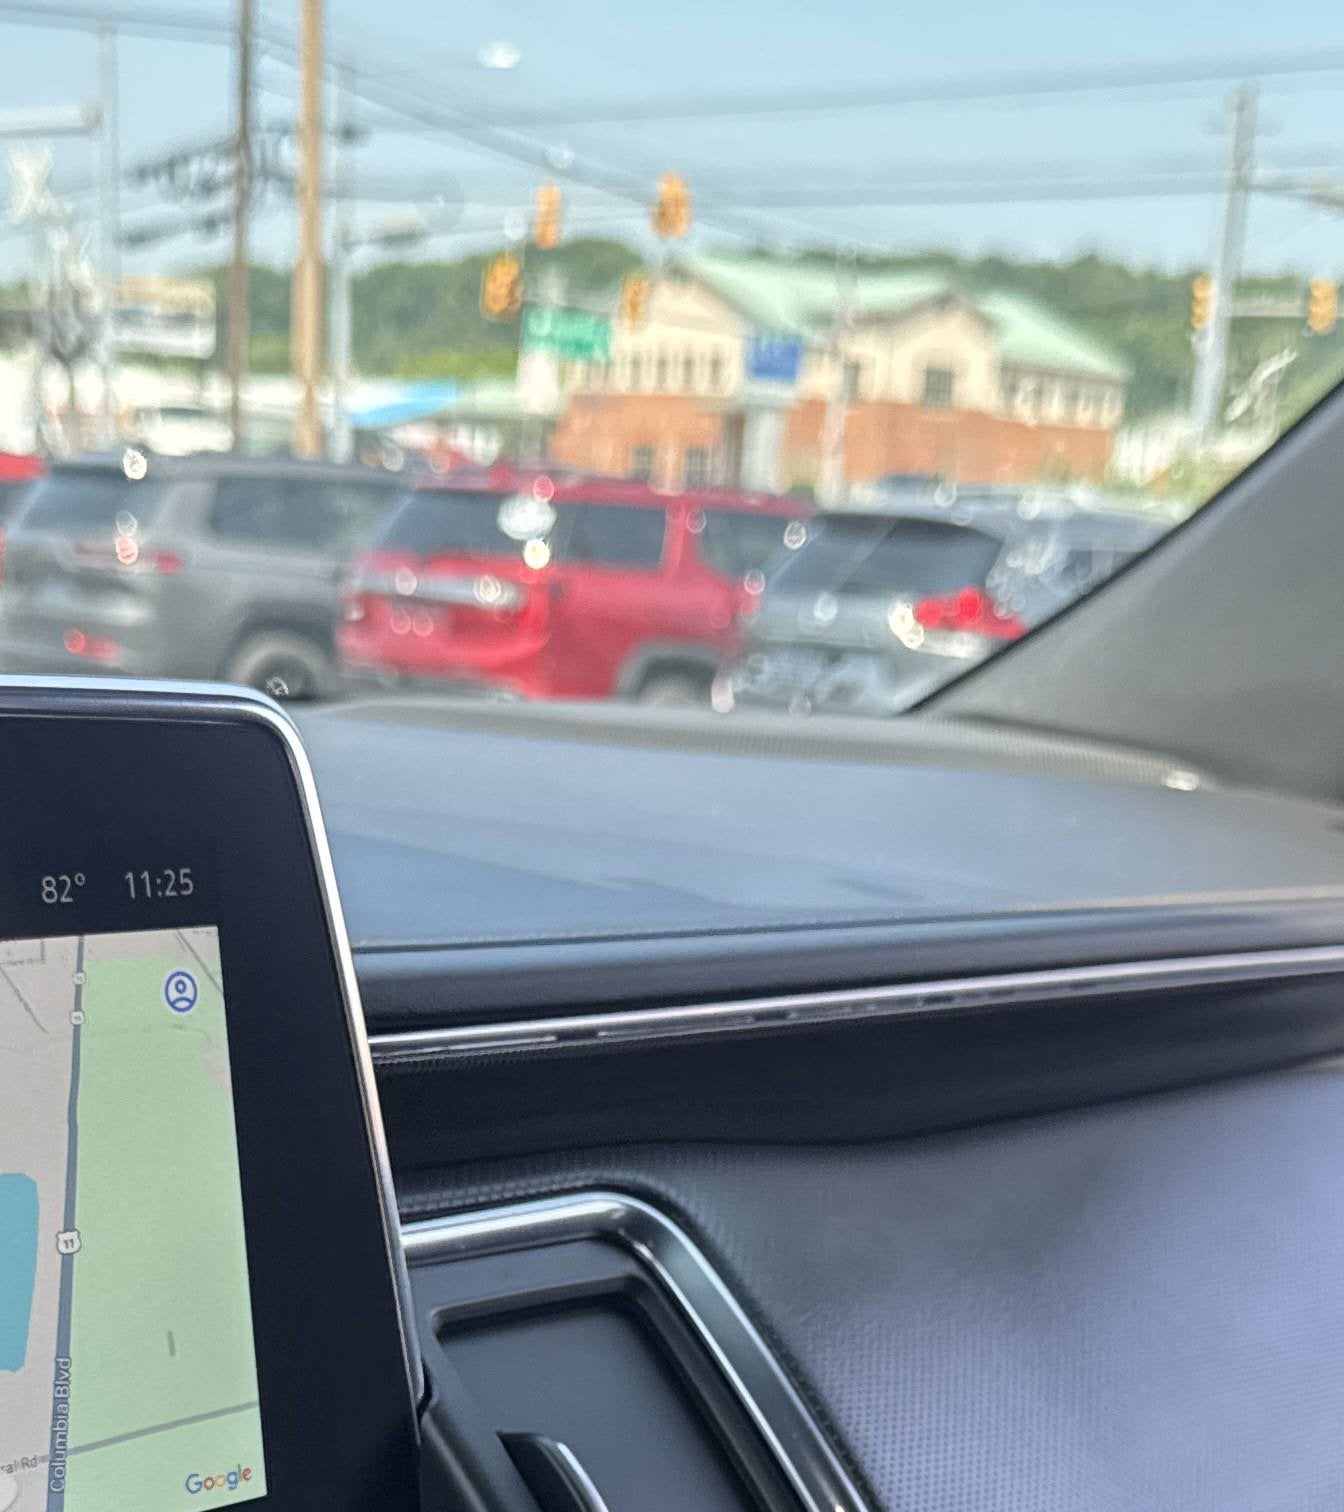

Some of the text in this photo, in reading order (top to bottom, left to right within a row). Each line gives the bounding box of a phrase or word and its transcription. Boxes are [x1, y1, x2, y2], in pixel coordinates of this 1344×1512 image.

[124, 868, 195, 900] 11:25
[50, 1356, 72, 1492] Columbia Blvd
[21, 1454, 38, 1470] Rd
[185, 1463, 252, 1495] Google
